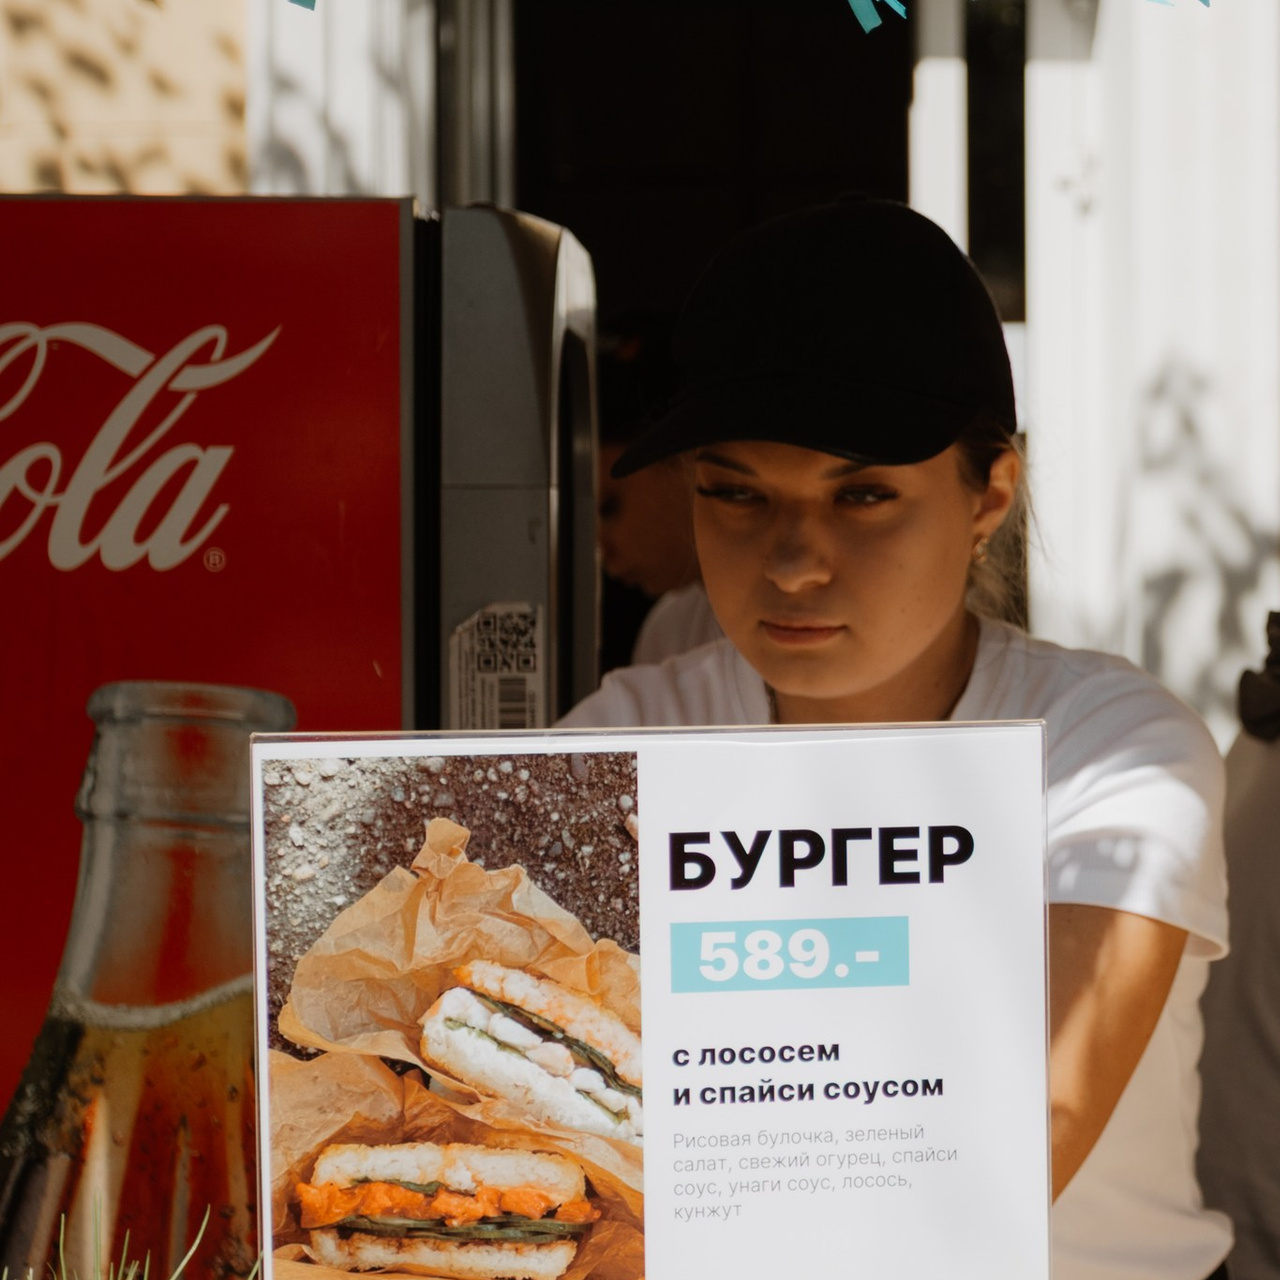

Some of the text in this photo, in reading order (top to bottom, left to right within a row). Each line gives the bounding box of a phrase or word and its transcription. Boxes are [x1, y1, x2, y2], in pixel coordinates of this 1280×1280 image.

[668, 824, 975, 892] БУРГЕР
[698, 928, 881, 983] 589.-
[671, 1042, 841, 1068] с лососем
[672, 1077, 944, 1107] и спайси соусом
[673, 1123, 925, 1150] Рисовая булочка, зеленый
[672, 1146, 958, 1174] салат, свежий огурец, спайси
[673, 1172, 913, 1200] соус, унаги соус, лосось,
[674, 1203, 743, 1223] кунжут
